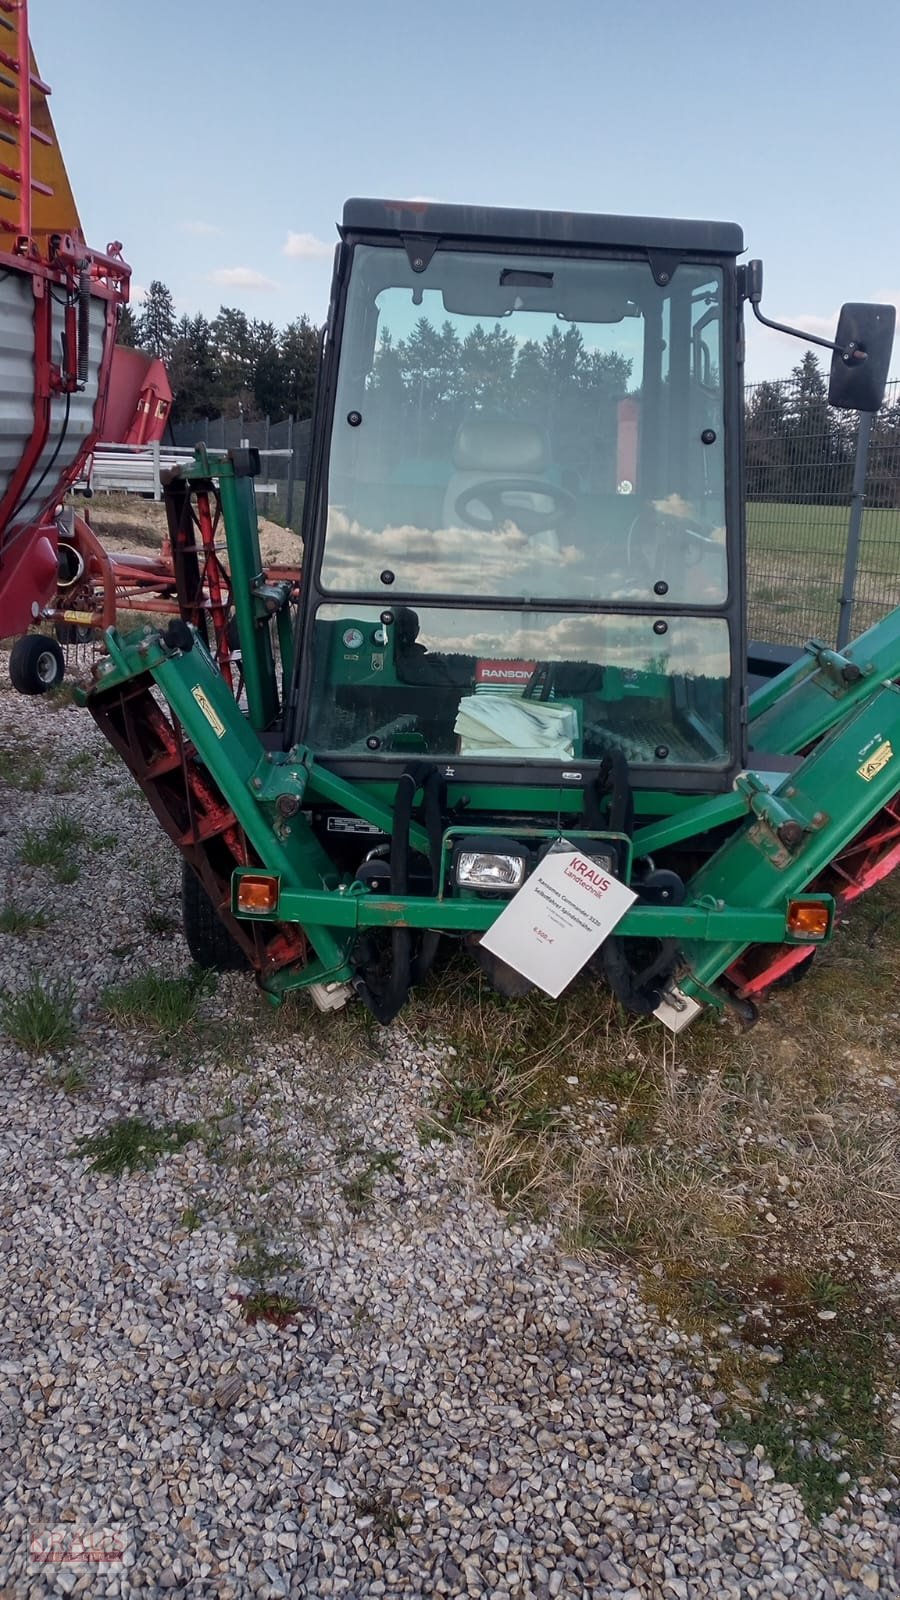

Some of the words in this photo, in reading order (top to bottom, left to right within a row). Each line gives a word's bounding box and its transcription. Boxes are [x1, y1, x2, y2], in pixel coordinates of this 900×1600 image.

[481, 669, 534, 679] RANSOM
[563, 867, 604, 900] Landtechnik
[569, 857, 611, 892] KRAUS
